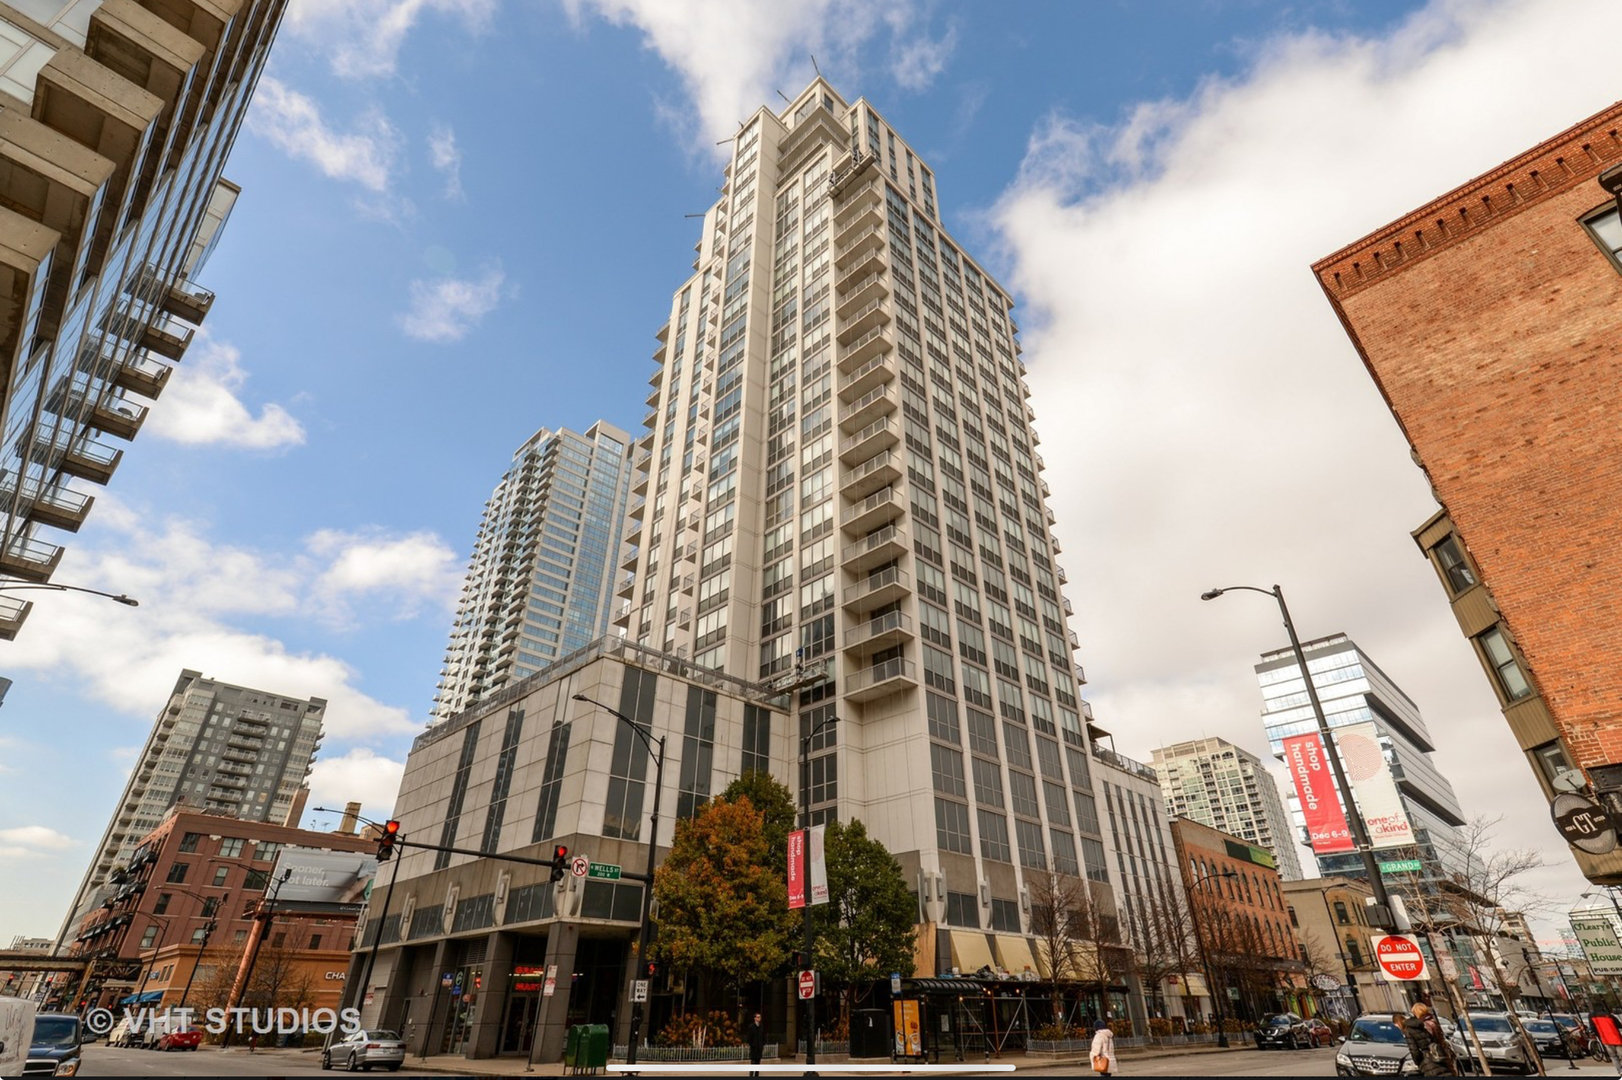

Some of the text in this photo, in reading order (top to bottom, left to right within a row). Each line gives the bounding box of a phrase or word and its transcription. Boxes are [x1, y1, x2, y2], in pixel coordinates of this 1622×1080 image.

[1305, 741, 1321, 771] shop
[1290, 743, 1319, 810] handmade
[1572, 812, 1598, 834] GT
[1311, 832, 1330, 840] Dec
[594, 865, 614, 873] WELLS
[1386, 862, 1414, 871] GRAND
[301, 876, 330, 887] later.
[1582, 937, 1616, 947] Public
[1380, 943, 1412, 952] DO NOT
[1589, 952, 1622, 962] House
[1389, 963, 1417, 971] ENTER
